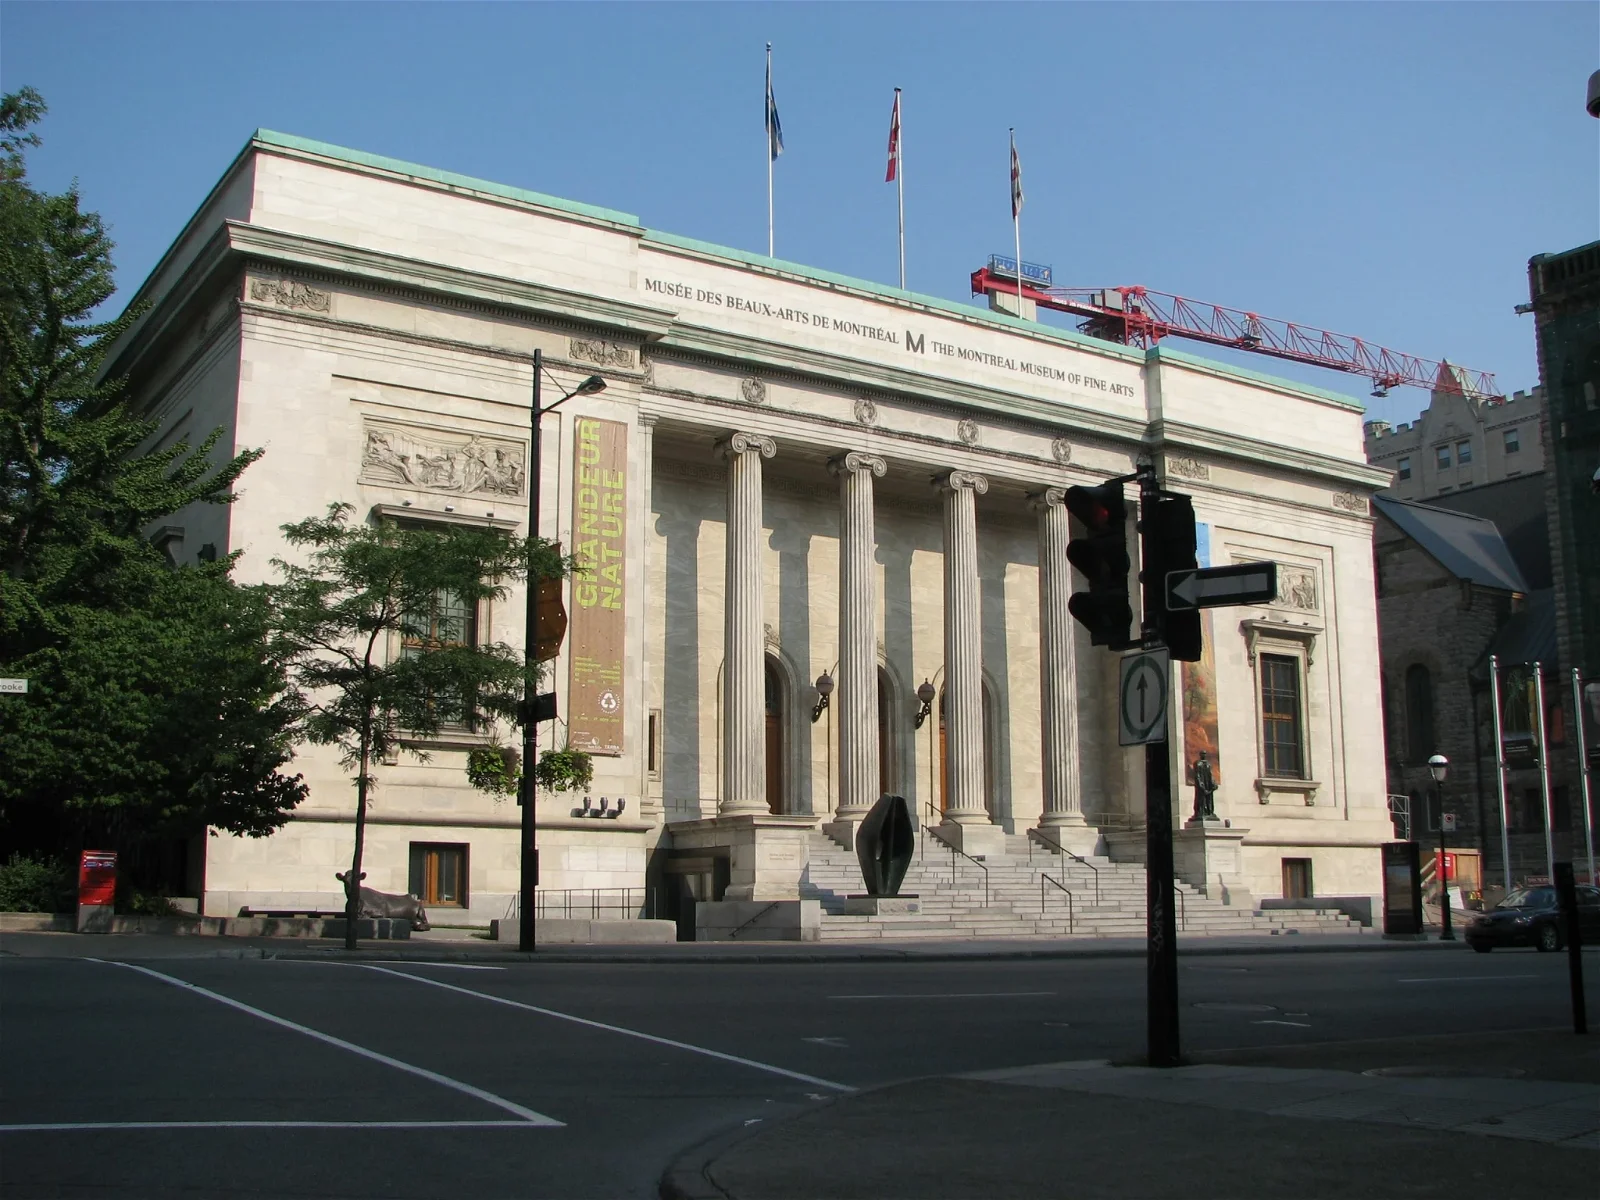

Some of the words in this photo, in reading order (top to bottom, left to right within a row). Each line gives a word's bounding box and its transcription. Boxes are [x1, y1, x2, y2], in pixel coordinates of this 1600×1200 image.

[645, 278, 693, 299] MUSÉE
[696, 289, 722, 306] DES
[726, 295, 809, 324] BEAUX-ARTS
[812, 314, 830, 329] DE
[833, 320, 899, 344] MONTRÉAL
[905, 330, 925, 355] M
[931, 341, 955, 357] THE
[957, 348, 1018, 371] MONTREAL
[1020, 361, 1066, 382] MUSEUM
[1067, 372, 1082, 385] OF
[1084, 375, 1107, 392] FINE
[1109, 382, 1134, 398] ARTS
[575, 419, 601, 608] GRANDEUR
[601, 469, 624, 610] NATURE
